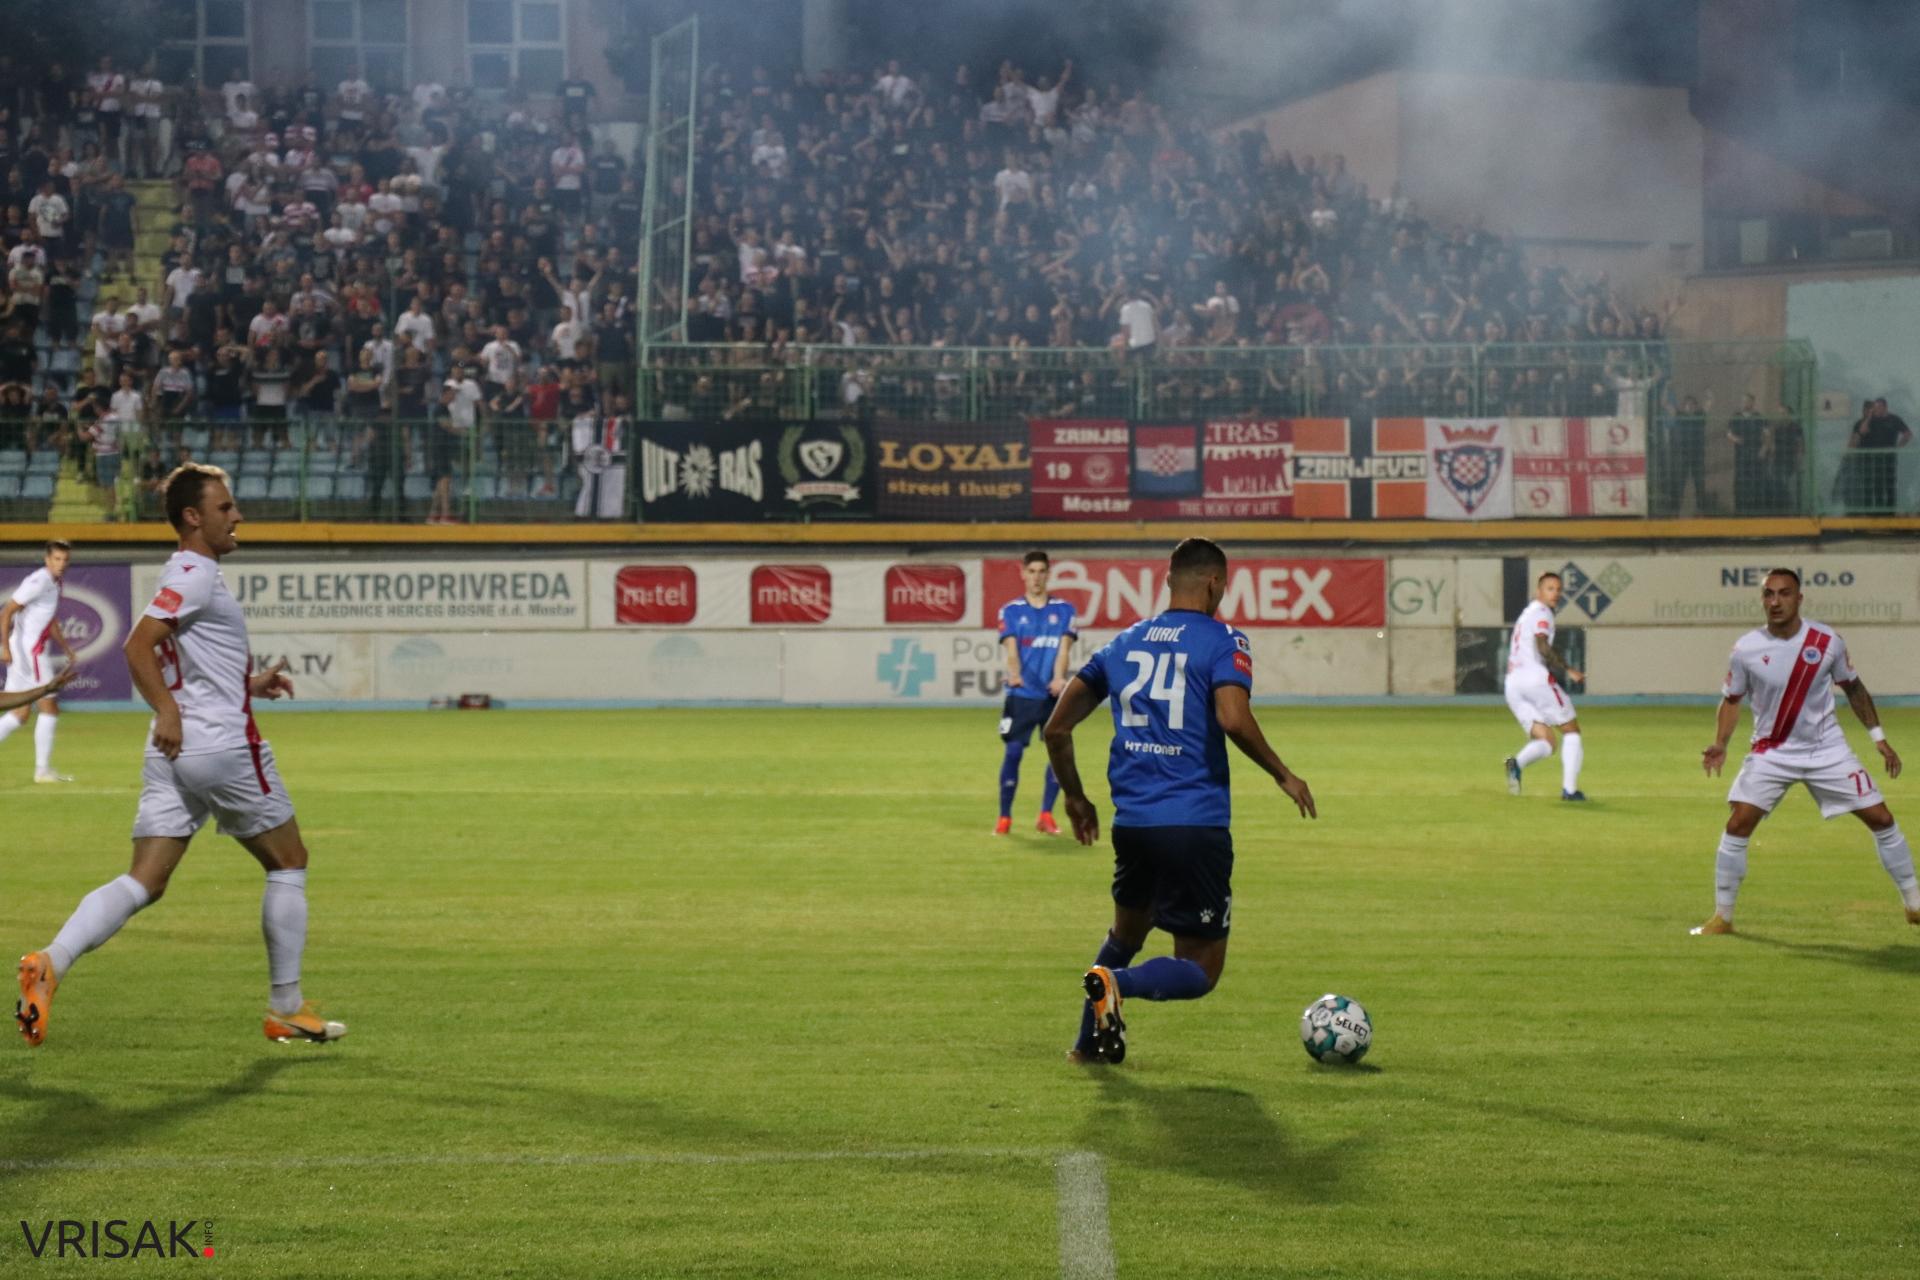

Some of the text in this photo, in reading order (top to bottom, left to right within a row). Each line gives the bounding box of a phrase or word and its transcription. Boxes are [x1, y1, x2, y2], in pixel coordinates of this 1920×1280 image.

[1204, 422, 1279, 443] TRAS
[879, 441, 1032, 471] LOYAL
[1529, 462, 1629, 474] ULTRAS
[888, 479, 1023, 499] street thugs
[1062, 495, 1132, 512] Mostar
[237, 573, 571, 602] JP ELEKTROPRIVREDA
[308, 604, 383, 619] ZAJEDNICE
[528, 603, 577, 617] Mostar
[1119, 650, 1188, 730] 24
[1334, 1016, 1368, 1041] SELECT
